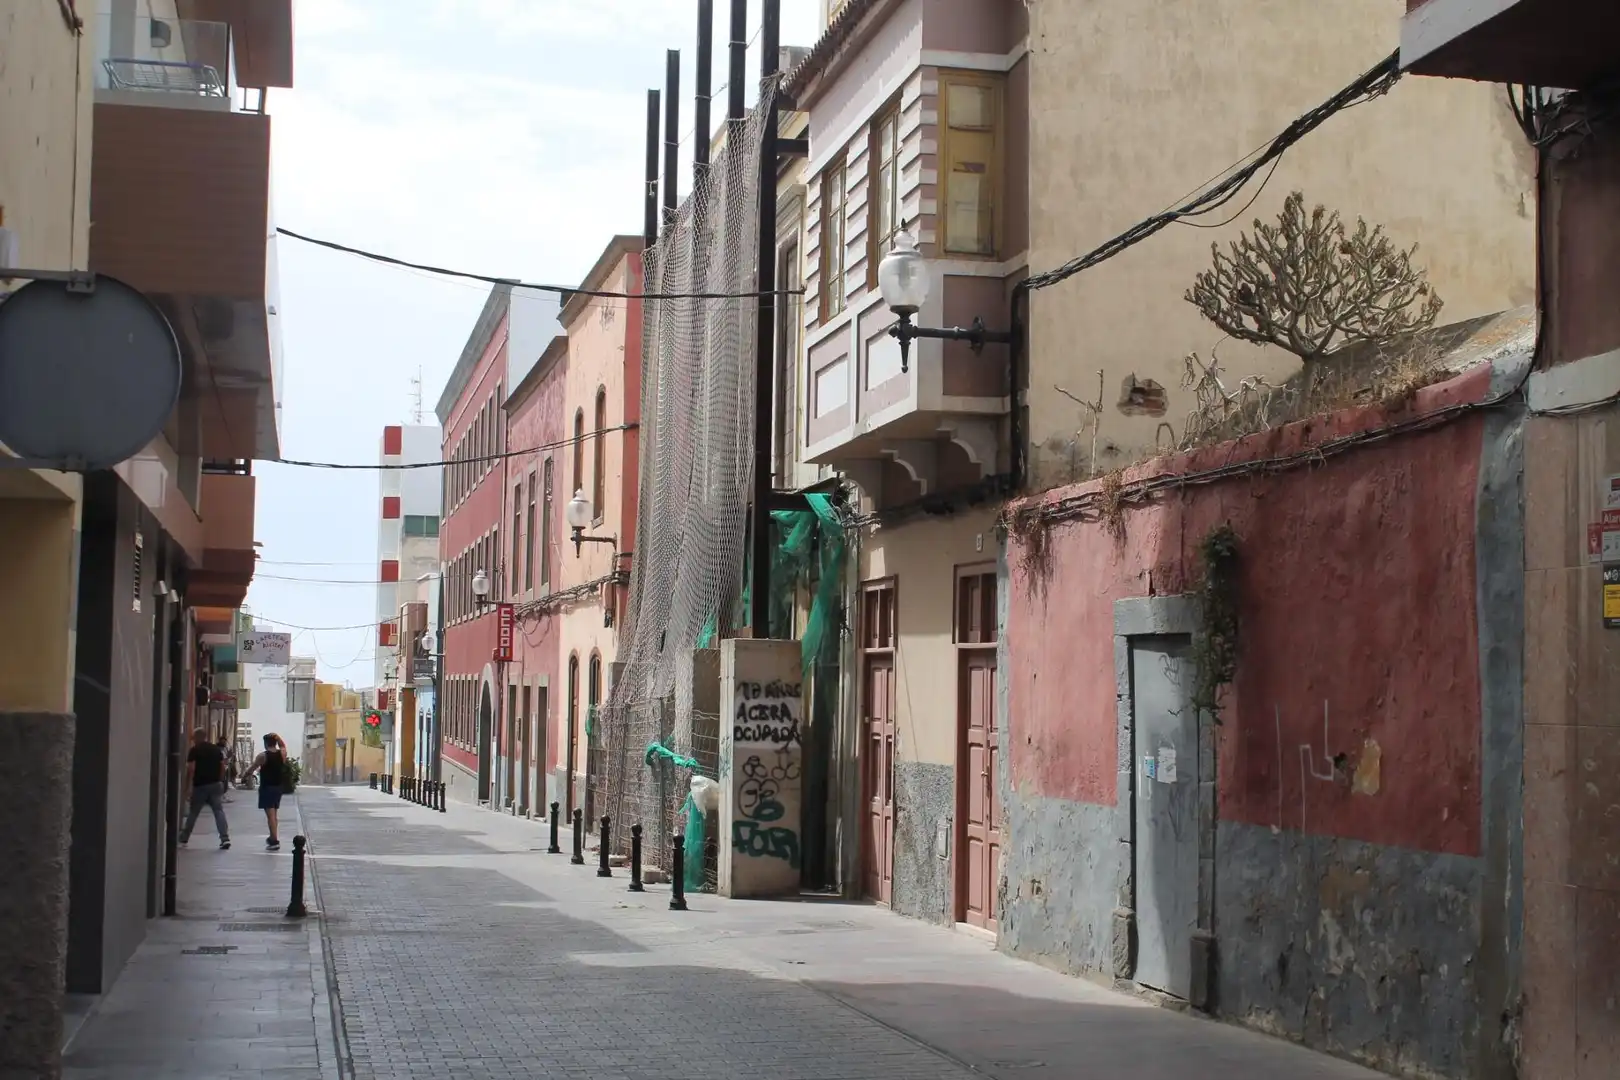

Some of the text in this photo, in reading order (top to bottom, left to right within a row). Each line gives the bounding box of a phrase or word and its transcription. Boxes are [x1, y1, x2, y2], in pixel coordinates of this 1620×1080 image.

[500, 607, 510, 647] CCOO
[736, 702, 792, 723] ACERA
[733, 718, 802, 744] OCUPADA
